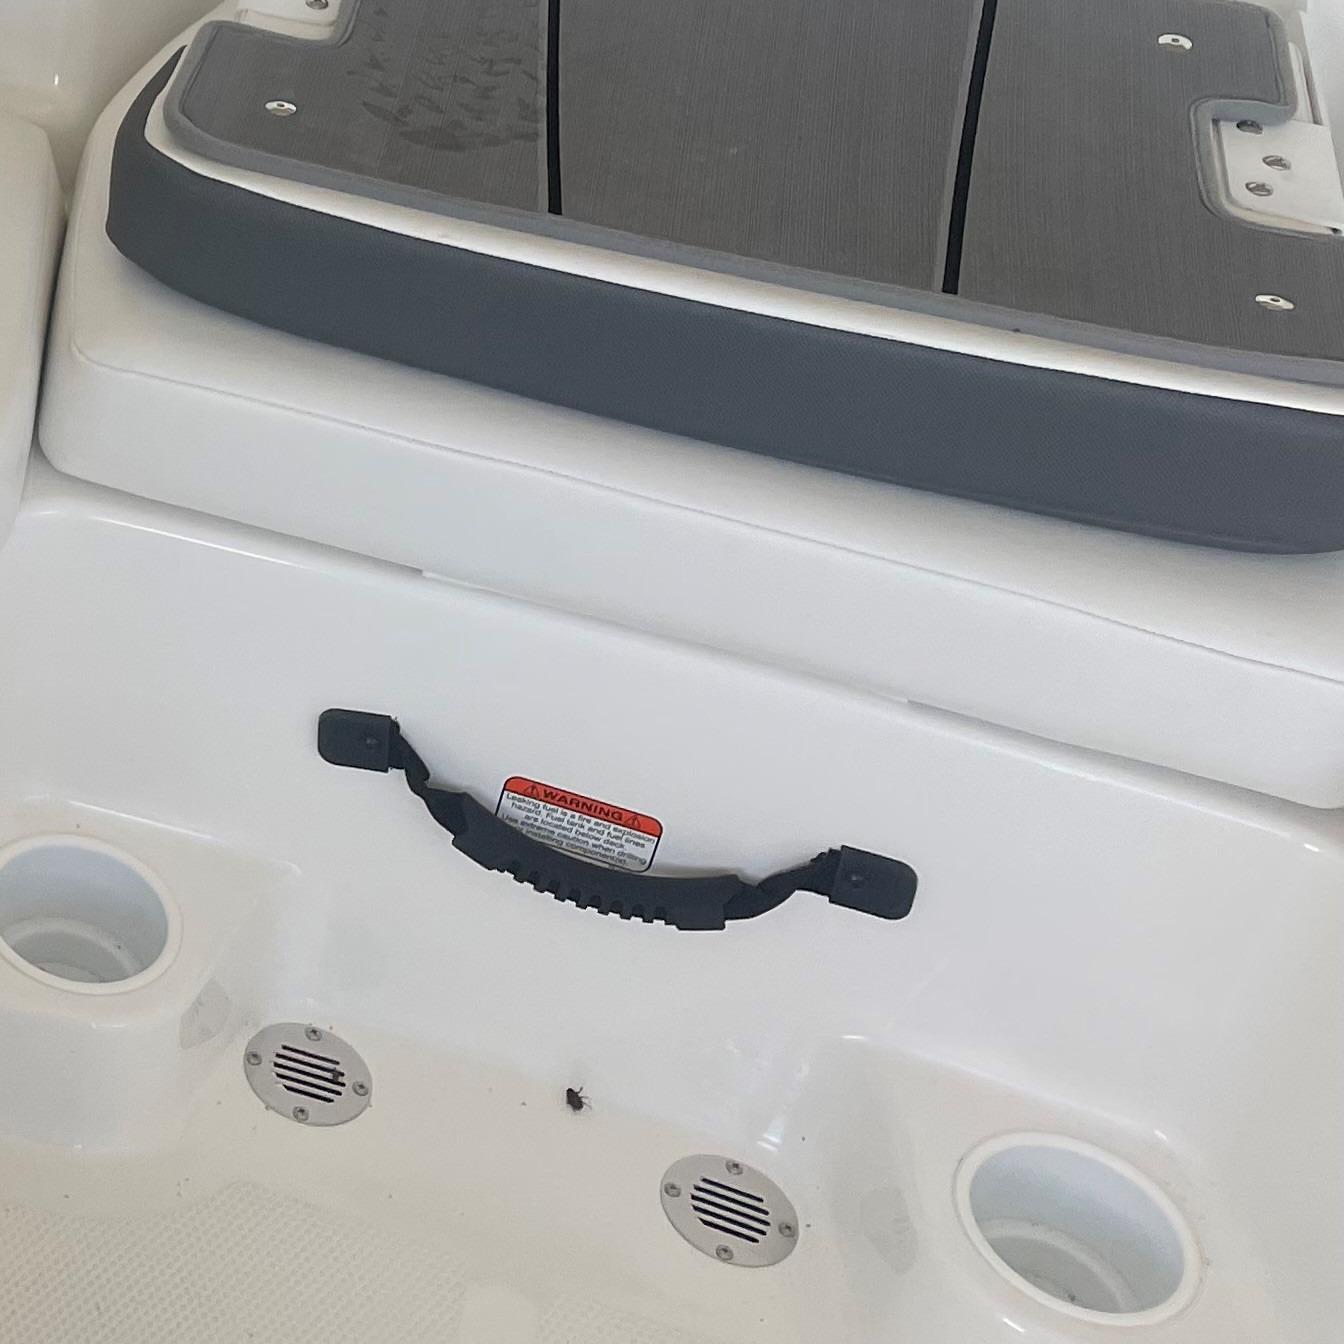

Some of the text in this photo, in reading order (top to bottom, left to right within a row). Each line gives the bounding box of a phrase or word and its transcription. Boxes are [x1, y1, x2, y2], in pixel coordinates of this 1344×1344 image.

[505, 793, 540, 809] Leaking
[542, 803, 558, 813] fuel
[577, 814, 591, 824] fire
[593, 819, 611, 830] and
[542, 789, 622, 820] WARNING
[519, 820, 555, 835] extreme
[556, 831, 589, 846] caution
[591, 841, 615, 853] when
[524, 814, 538, 822] are
[540, 818, 573, 833] located
[574, 828, 601, 842] below
[545, 812, 564, 823] Fuel
[566, 819, 585, 829] tank
[587, 825, 604, 836] and
[606, 831, 622, 841] fuel
